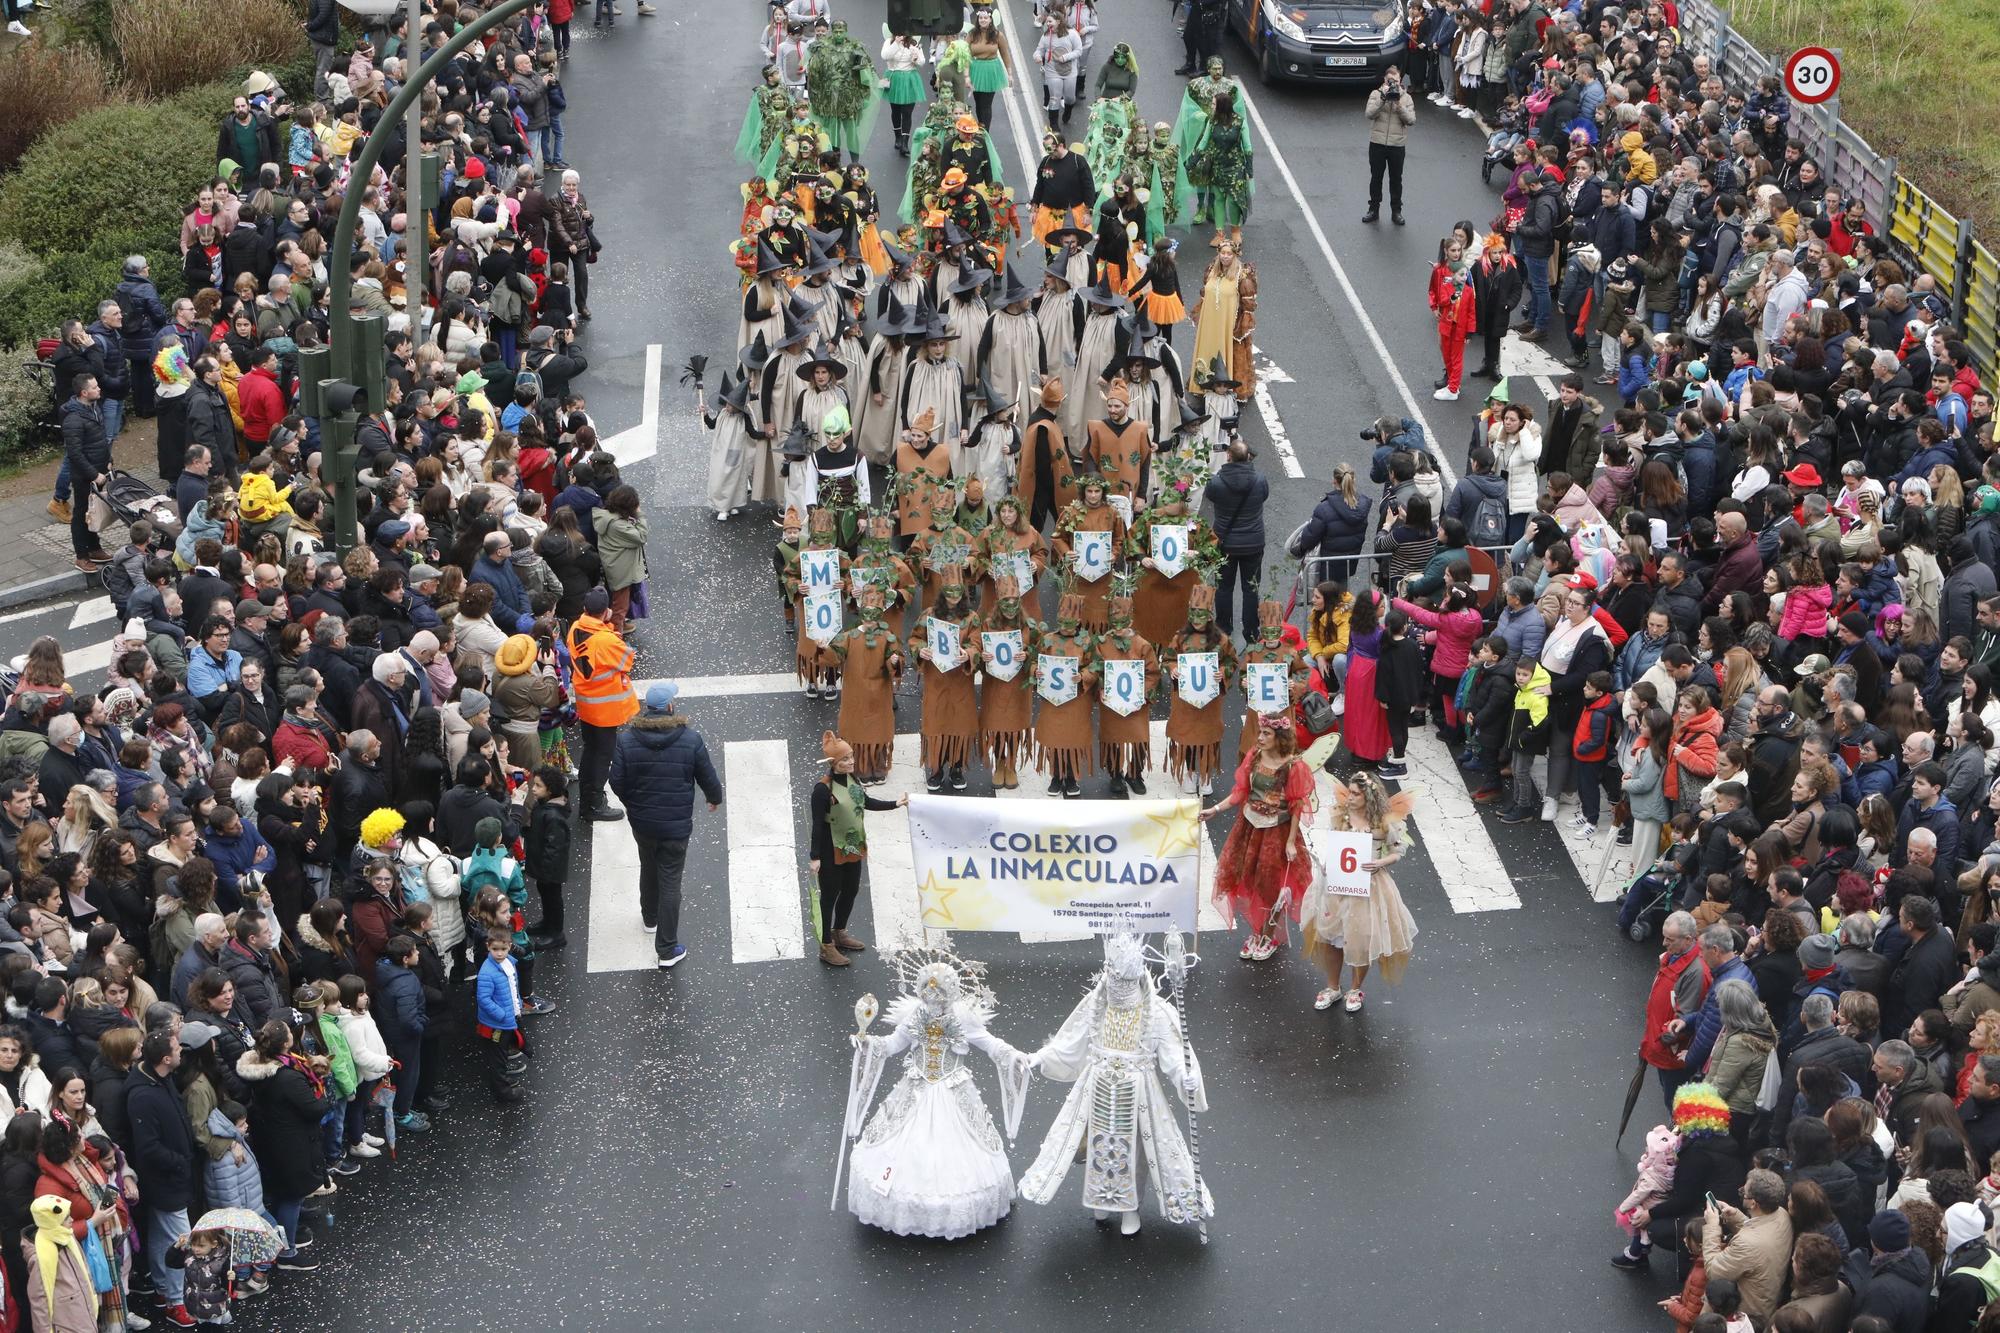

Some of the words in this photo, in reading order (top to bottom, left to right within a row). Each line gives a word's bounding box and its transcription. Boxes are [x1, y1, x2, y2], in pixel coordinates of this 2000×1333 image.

[1798, 66, 1828, 84] 30
[1085, 542, 1099, 567] C
[1162, 536, 1177, 561] O
[811, 562, 831, 586] M
[816, 604, 832, 629] O
[938, 631, 950, 655] B
[995, 642, 1012, 666] O
[1050, 667, 1065, 690] S
[1116, 672, 1132, 702] Q
[1191, 665, 1207, 692] U
[1261, 675, 1275, 701] E
[989, 832, 1118, 854] COLEXIO
[947, 857, 980, 880] LA
[991, 857, 1179, 885] INMACULADA
[1340, 847, 1357, 873] 6
[1327, 885, 1369, 895] COMPARSA
[1070, 900, 1114, 908] Concepción
[1079, 910, 1113, 918] Santiago
[1125, 911, 1171, 919] Compostela
[883, 1166, 892, 1181] 3
